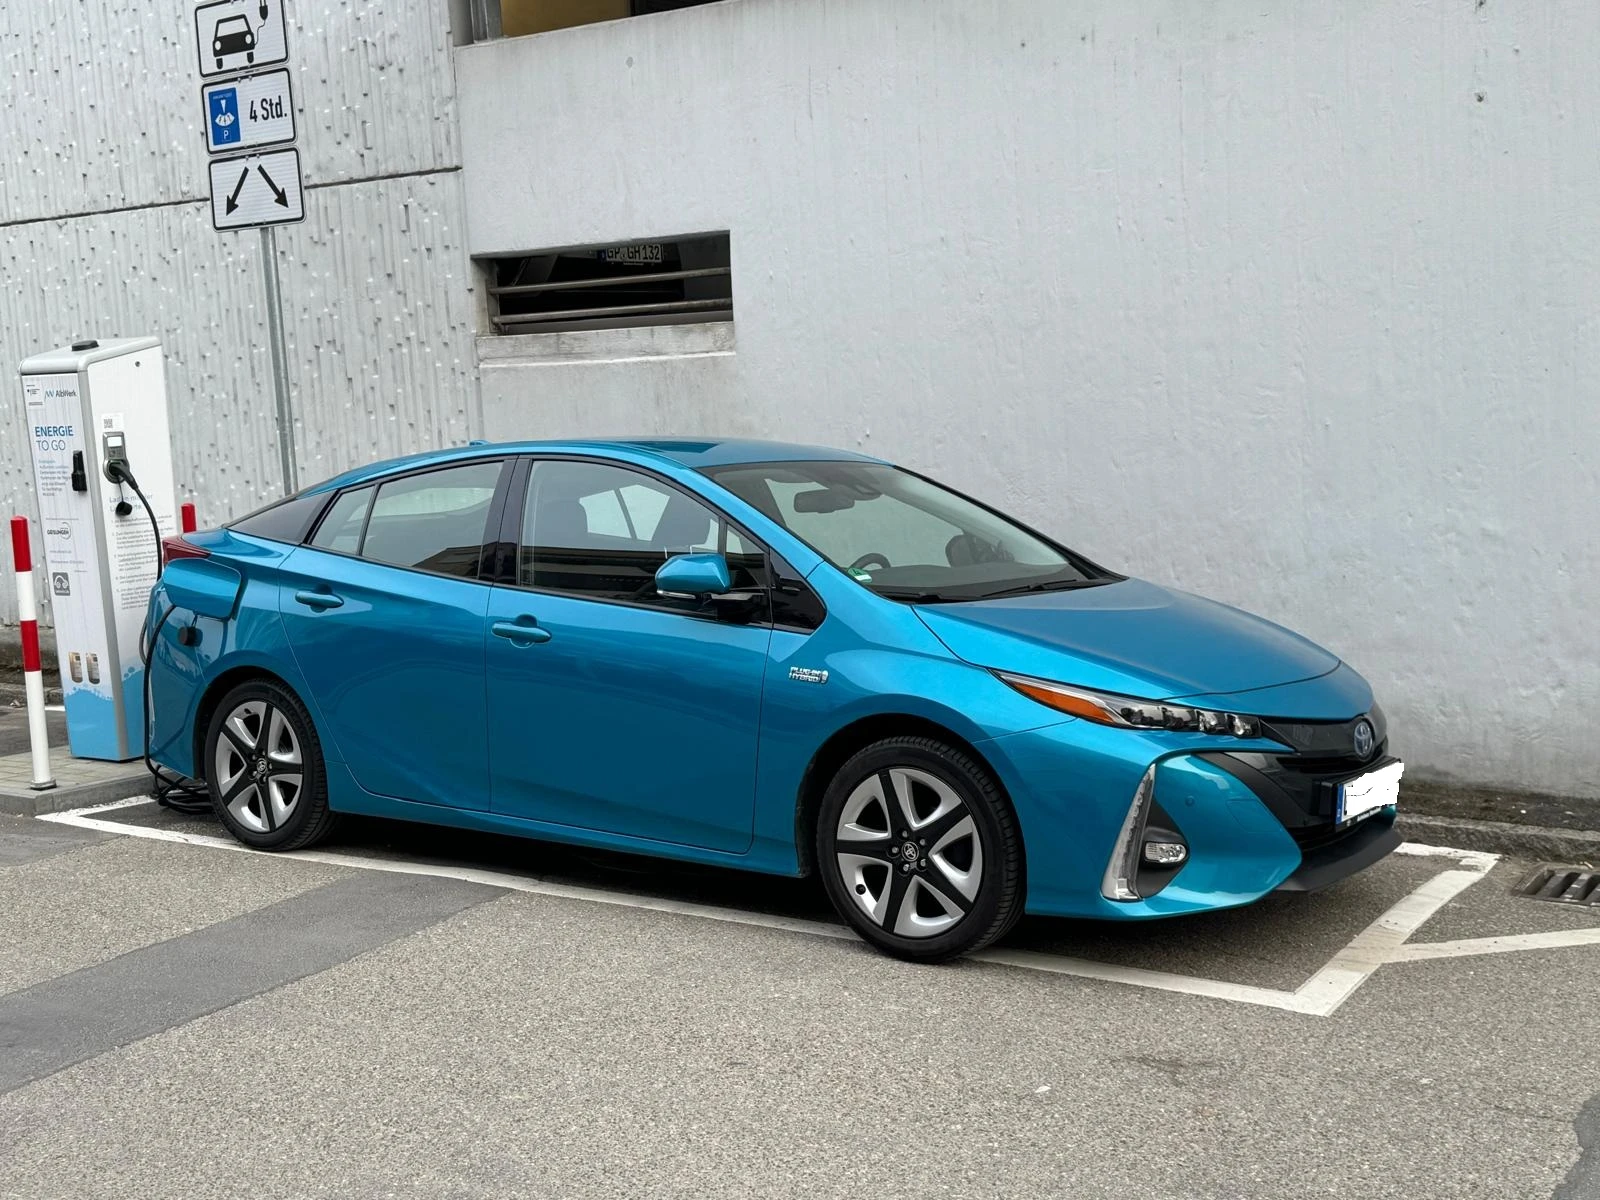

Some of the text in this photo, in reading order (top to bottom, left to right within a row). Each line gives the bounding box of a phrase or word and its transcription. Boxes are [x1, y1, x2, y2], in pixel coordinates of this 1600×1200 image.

[249, 95, 287, 122] 4 Std.
[223, 129, 229, 140] P
[607, 244, 660, 260] GP GH 132
[35, 425, 74, 437] ENERGIE
[36, 439, 66, 451] TO GO
